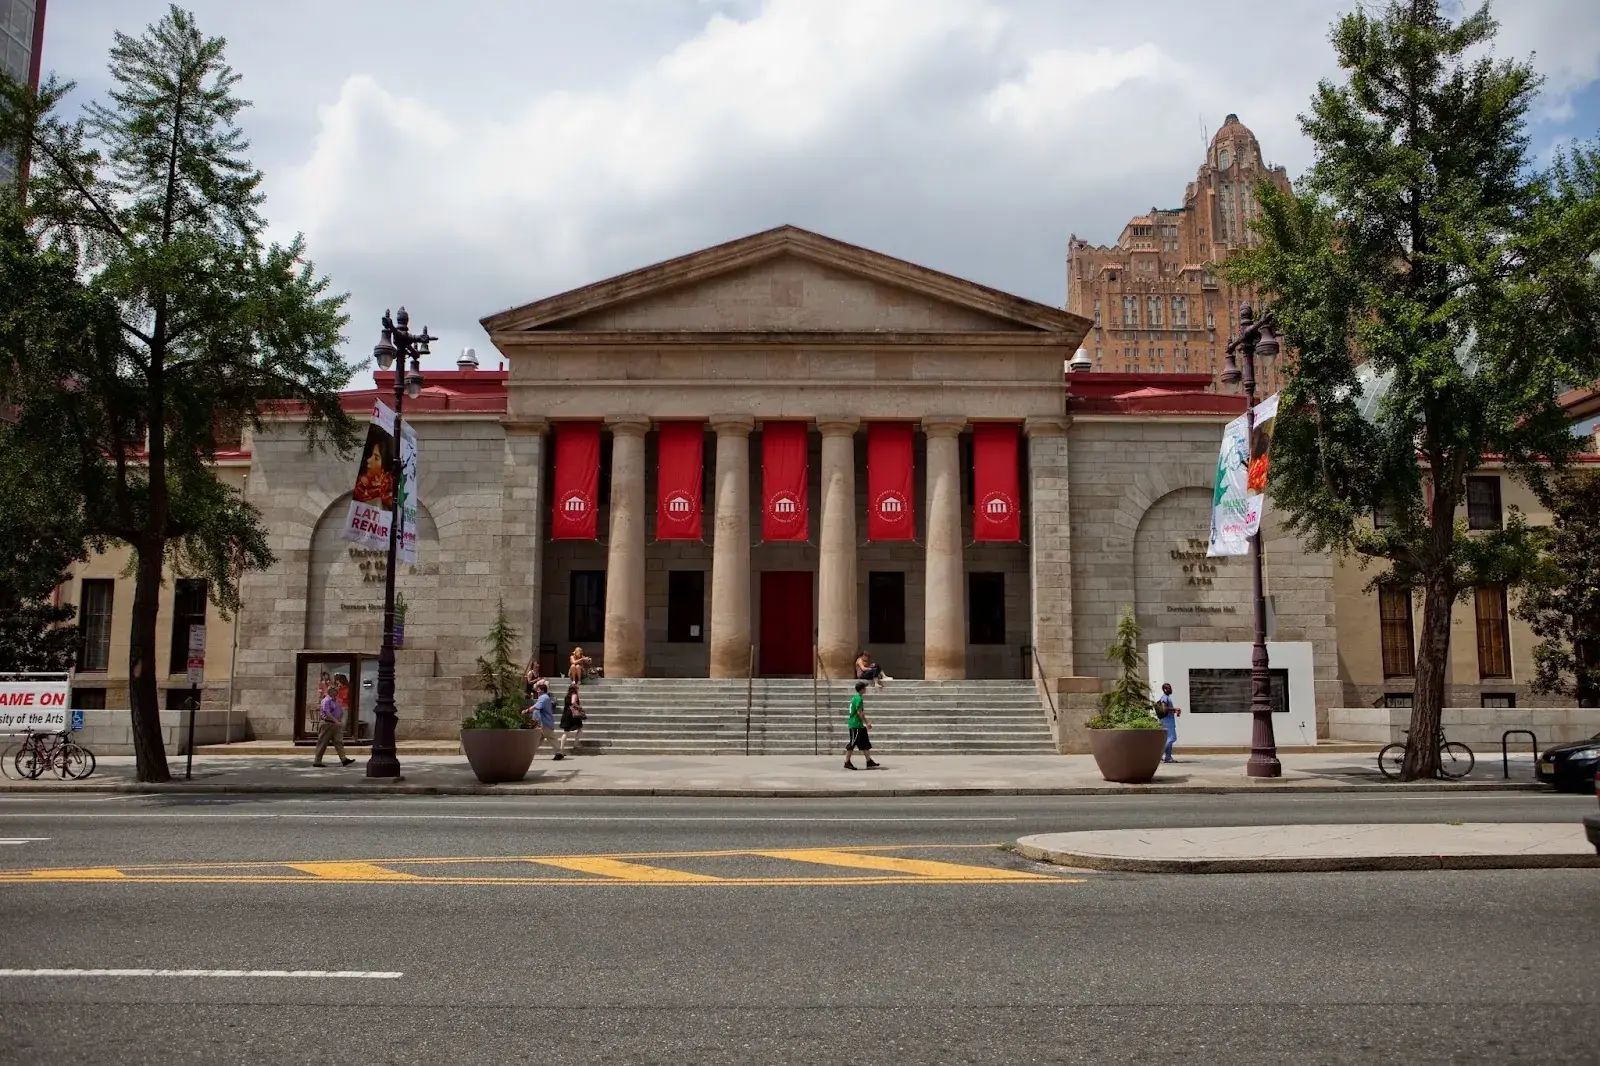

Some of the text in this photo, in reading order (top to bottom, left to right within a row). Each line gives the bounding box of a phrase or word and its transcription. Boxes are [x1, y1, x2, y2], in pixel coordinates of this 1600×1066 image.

[1182, 563, 1216, 573] of the
[1188, 576, 1212, 585] Arts
[40, 692, 66, 706] ON
[16, 712, 26, 724] of
[29, 713, 43, 724] the
[45, 713, 64, 724] Arts
